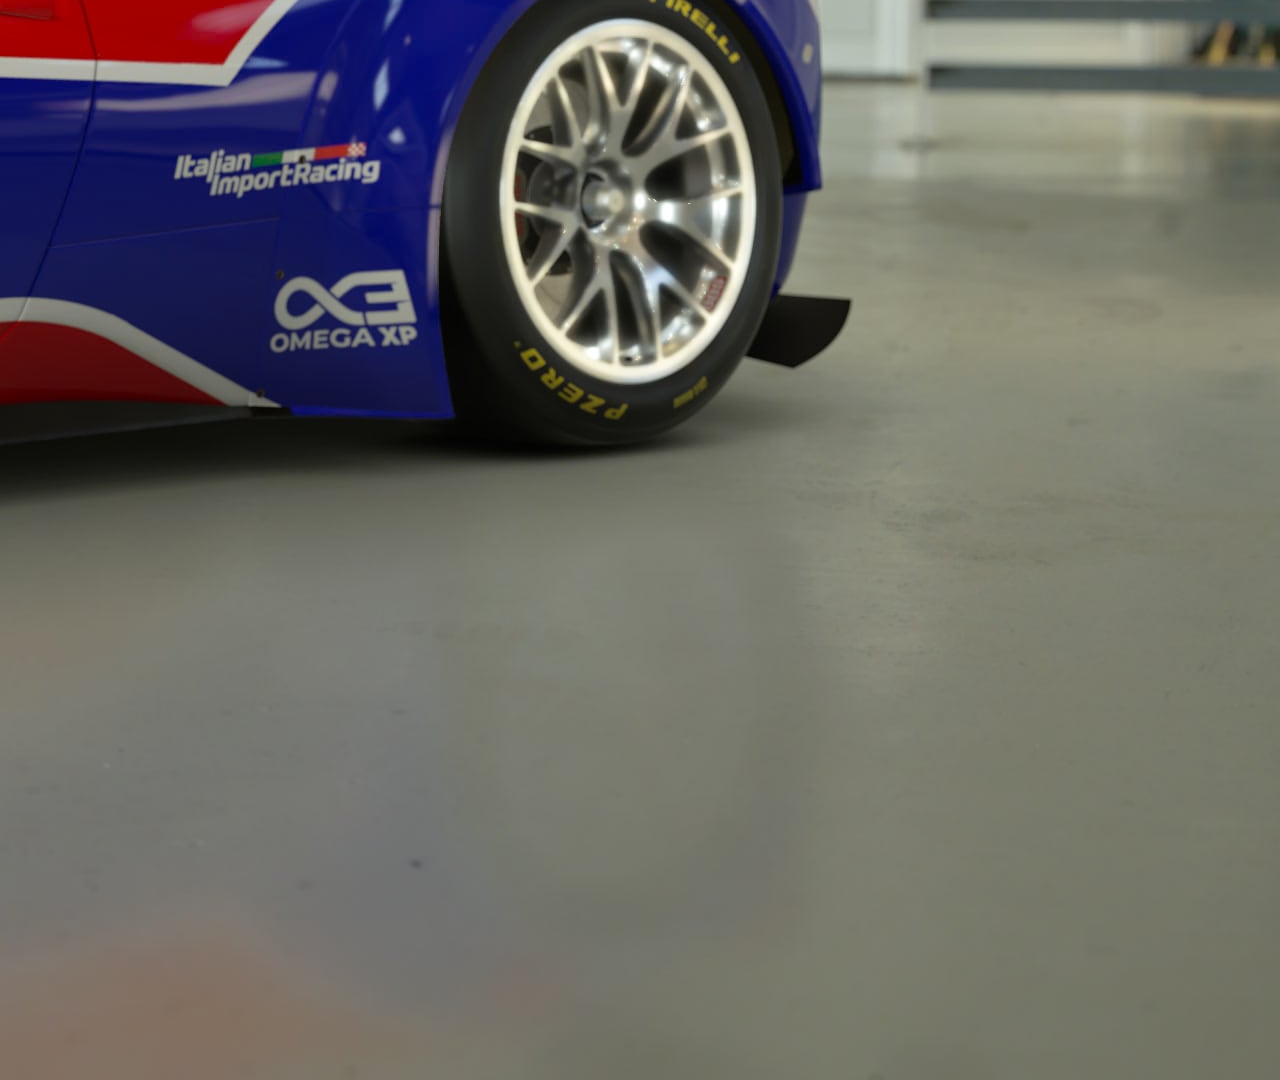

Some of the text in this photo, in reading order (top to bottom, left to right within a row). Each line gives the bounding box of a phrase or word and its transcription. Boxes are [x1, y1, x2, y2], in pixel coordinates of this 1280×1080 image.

[174, 149, 251, 184] Italian
[270, 325, 418, 353] OMEGA XP
